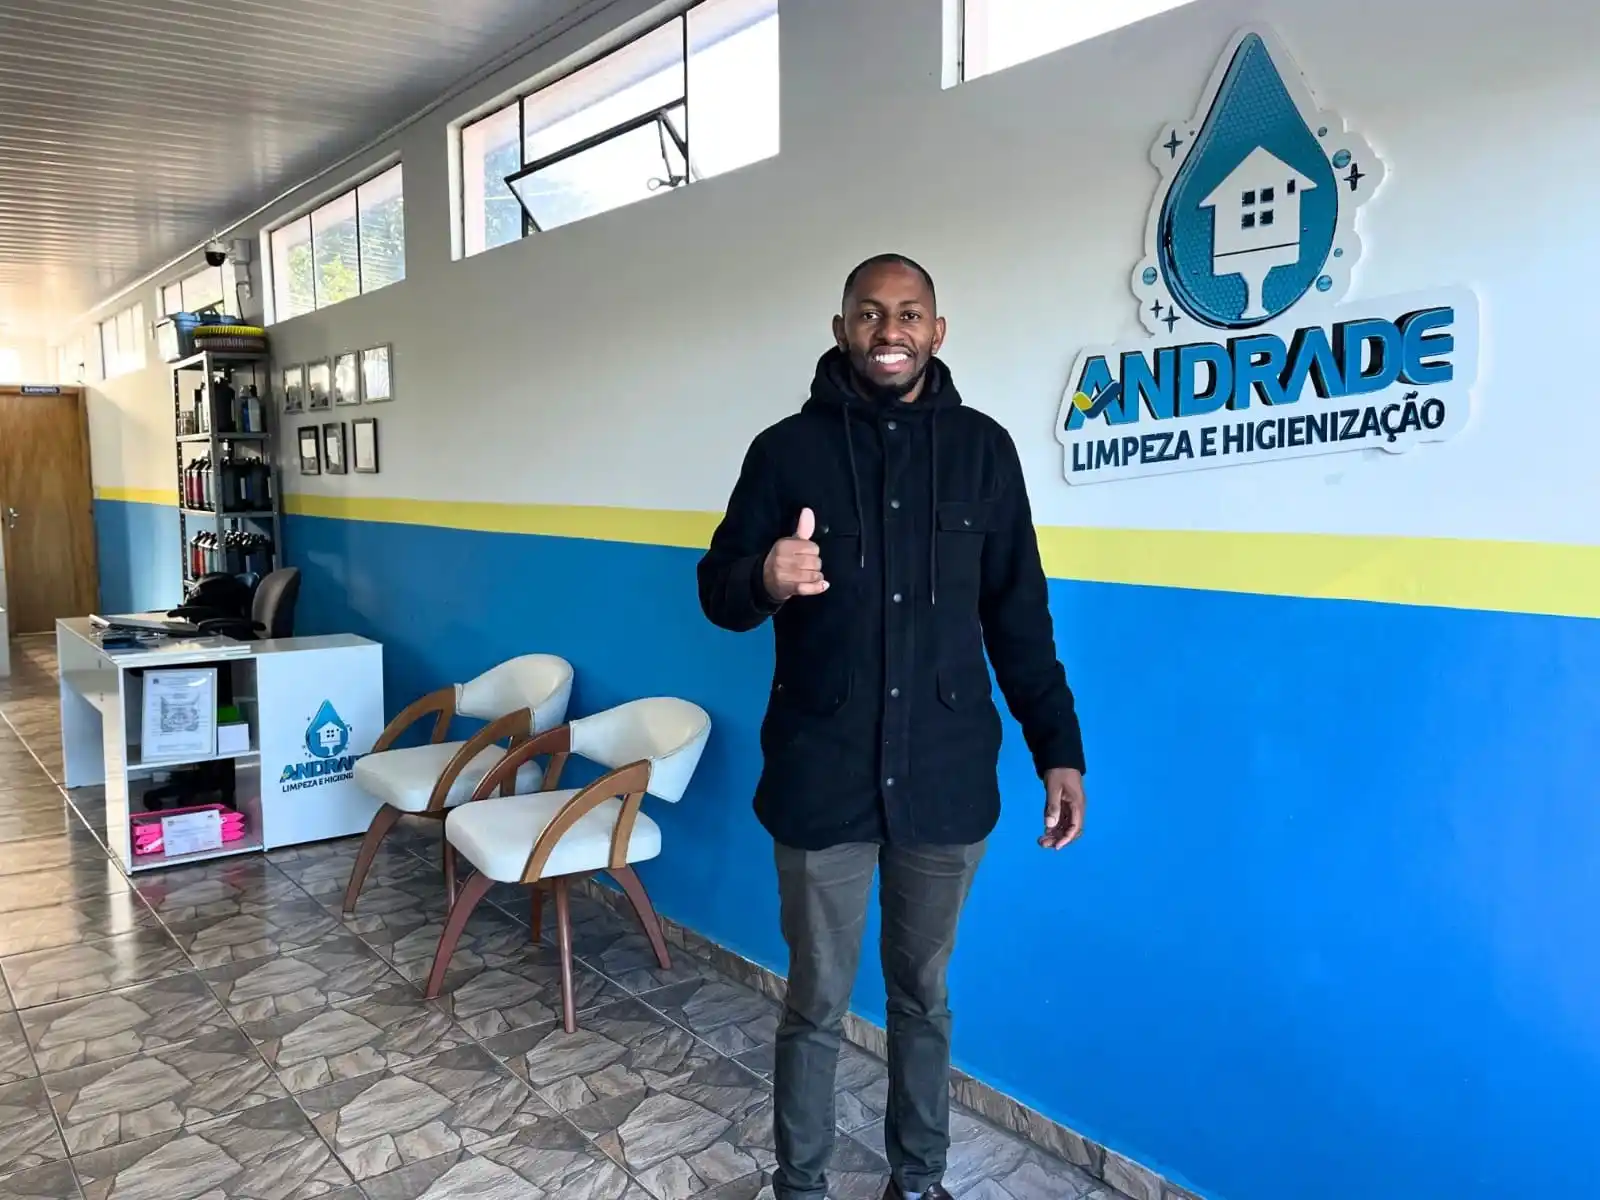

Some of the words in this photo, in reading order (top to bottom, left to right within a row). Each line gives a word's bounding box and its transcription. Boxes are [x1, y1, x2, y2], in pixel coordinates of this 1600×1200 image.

[1064, 306, 1454, 431] ANDRADE
[1072, 430, 1194, 472] LIMPEZA
[1200, 426, 1217, 457] E
[1223, 392, 1446, 454] HIGIENIZAÇÃO
[282, 780, 317, 792] LIMPEZA
